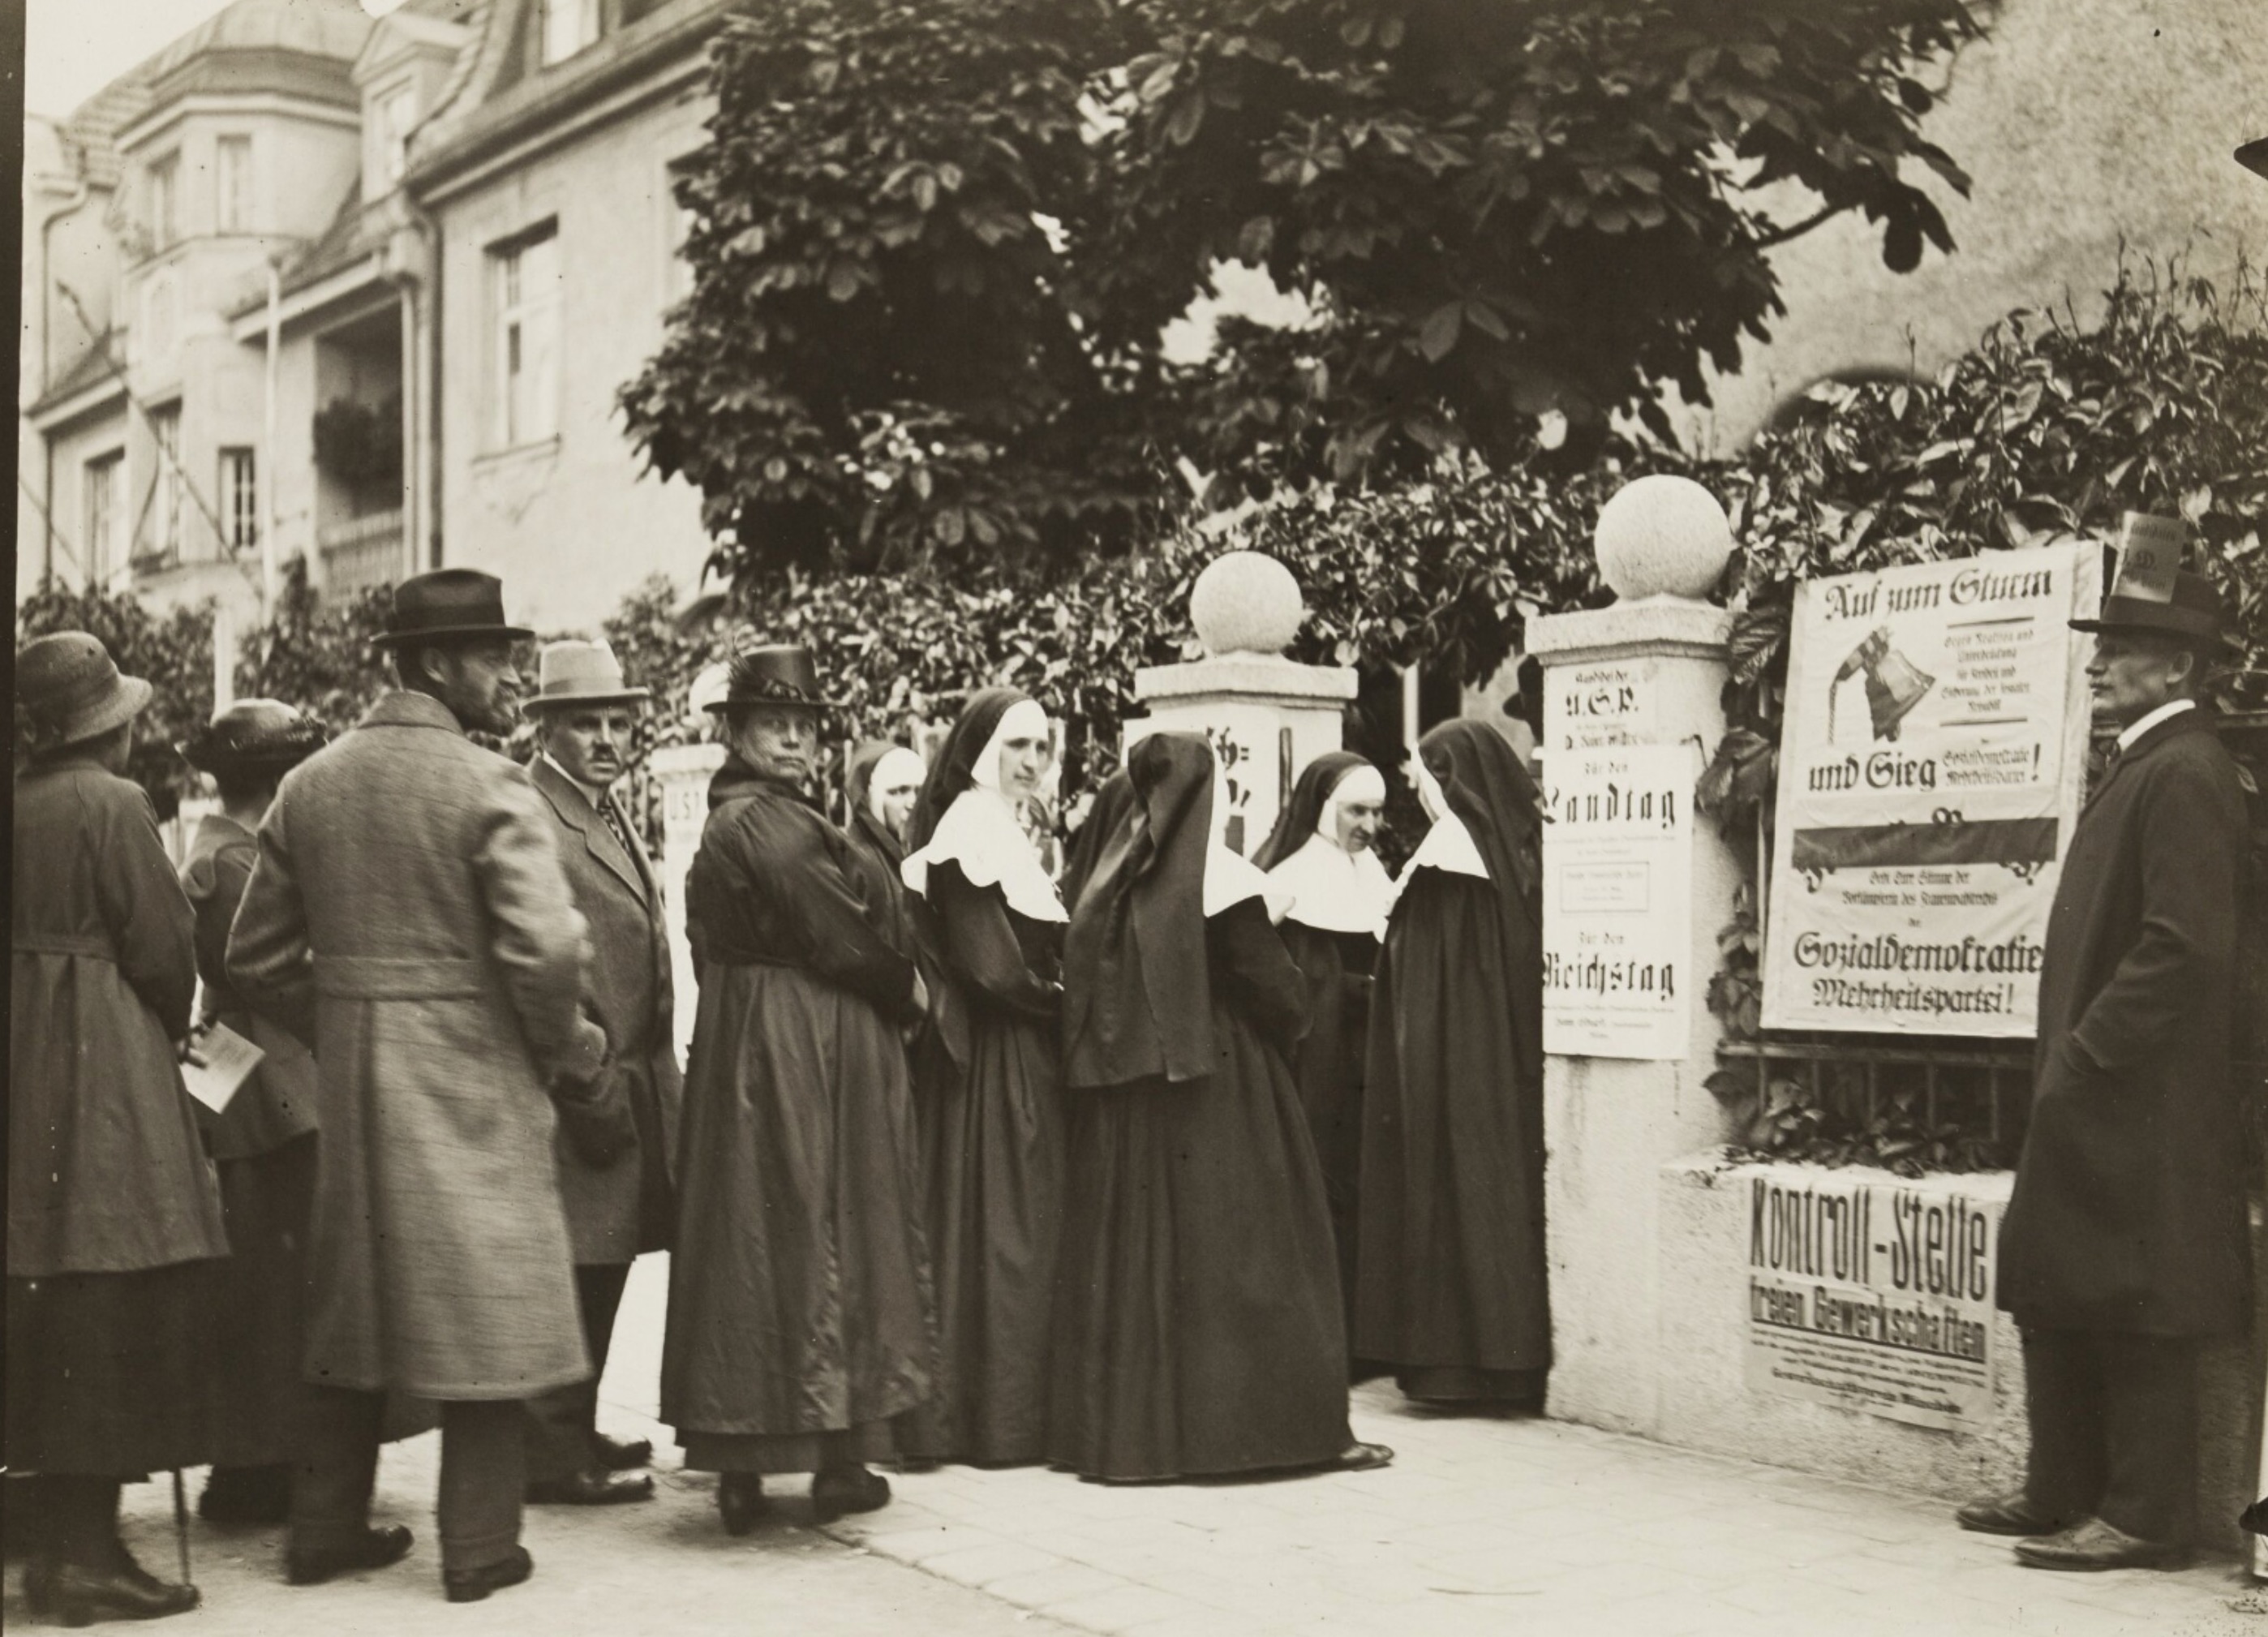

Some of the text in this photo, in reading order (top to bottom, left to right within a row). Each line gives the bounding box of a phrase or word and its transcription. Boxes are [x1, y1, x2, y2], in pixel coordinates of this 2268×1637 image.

[1888, 582, 1941, 613] zum
[1949, 569, 2052, 605] Sturm
[1809, 751, 1936, 792] und Sieg
[1542, 782, 1675, 830] Landtag
[1793, 931, 2044, 973] Sozialdemokratie
[1542, 952, 1674, 1002] Reichstag
[1813, 978, 2013, 1016] Mehrheitspartei!
